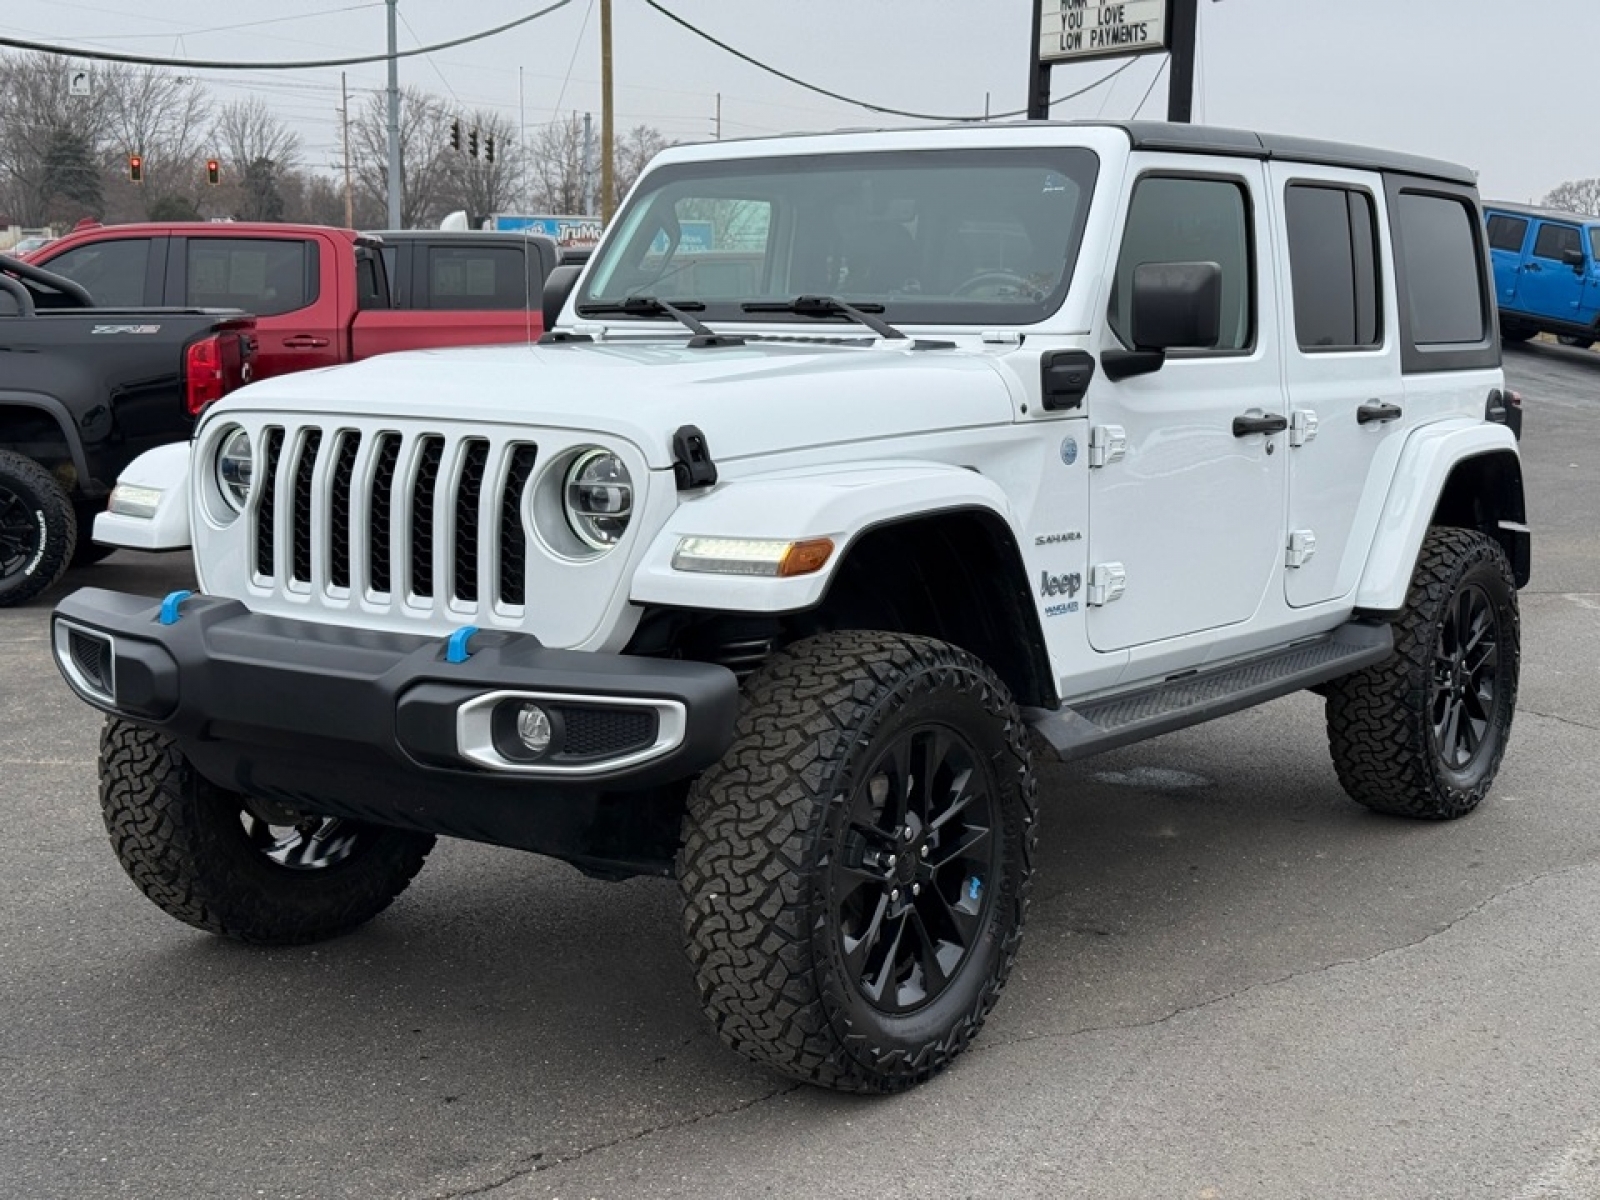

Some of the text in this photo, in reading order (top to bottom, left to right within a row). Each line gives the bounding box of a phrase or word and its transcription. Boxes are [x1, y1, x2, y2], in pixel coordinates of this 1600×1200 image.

[1061, 5, 1124, 30] YOU LOVE
[1060, 23, 1147, 50] LOW PAYMENTS
[1035, 532, 1082, 545] SAHARA
[1040, 570, 1081, 598] Jeep
